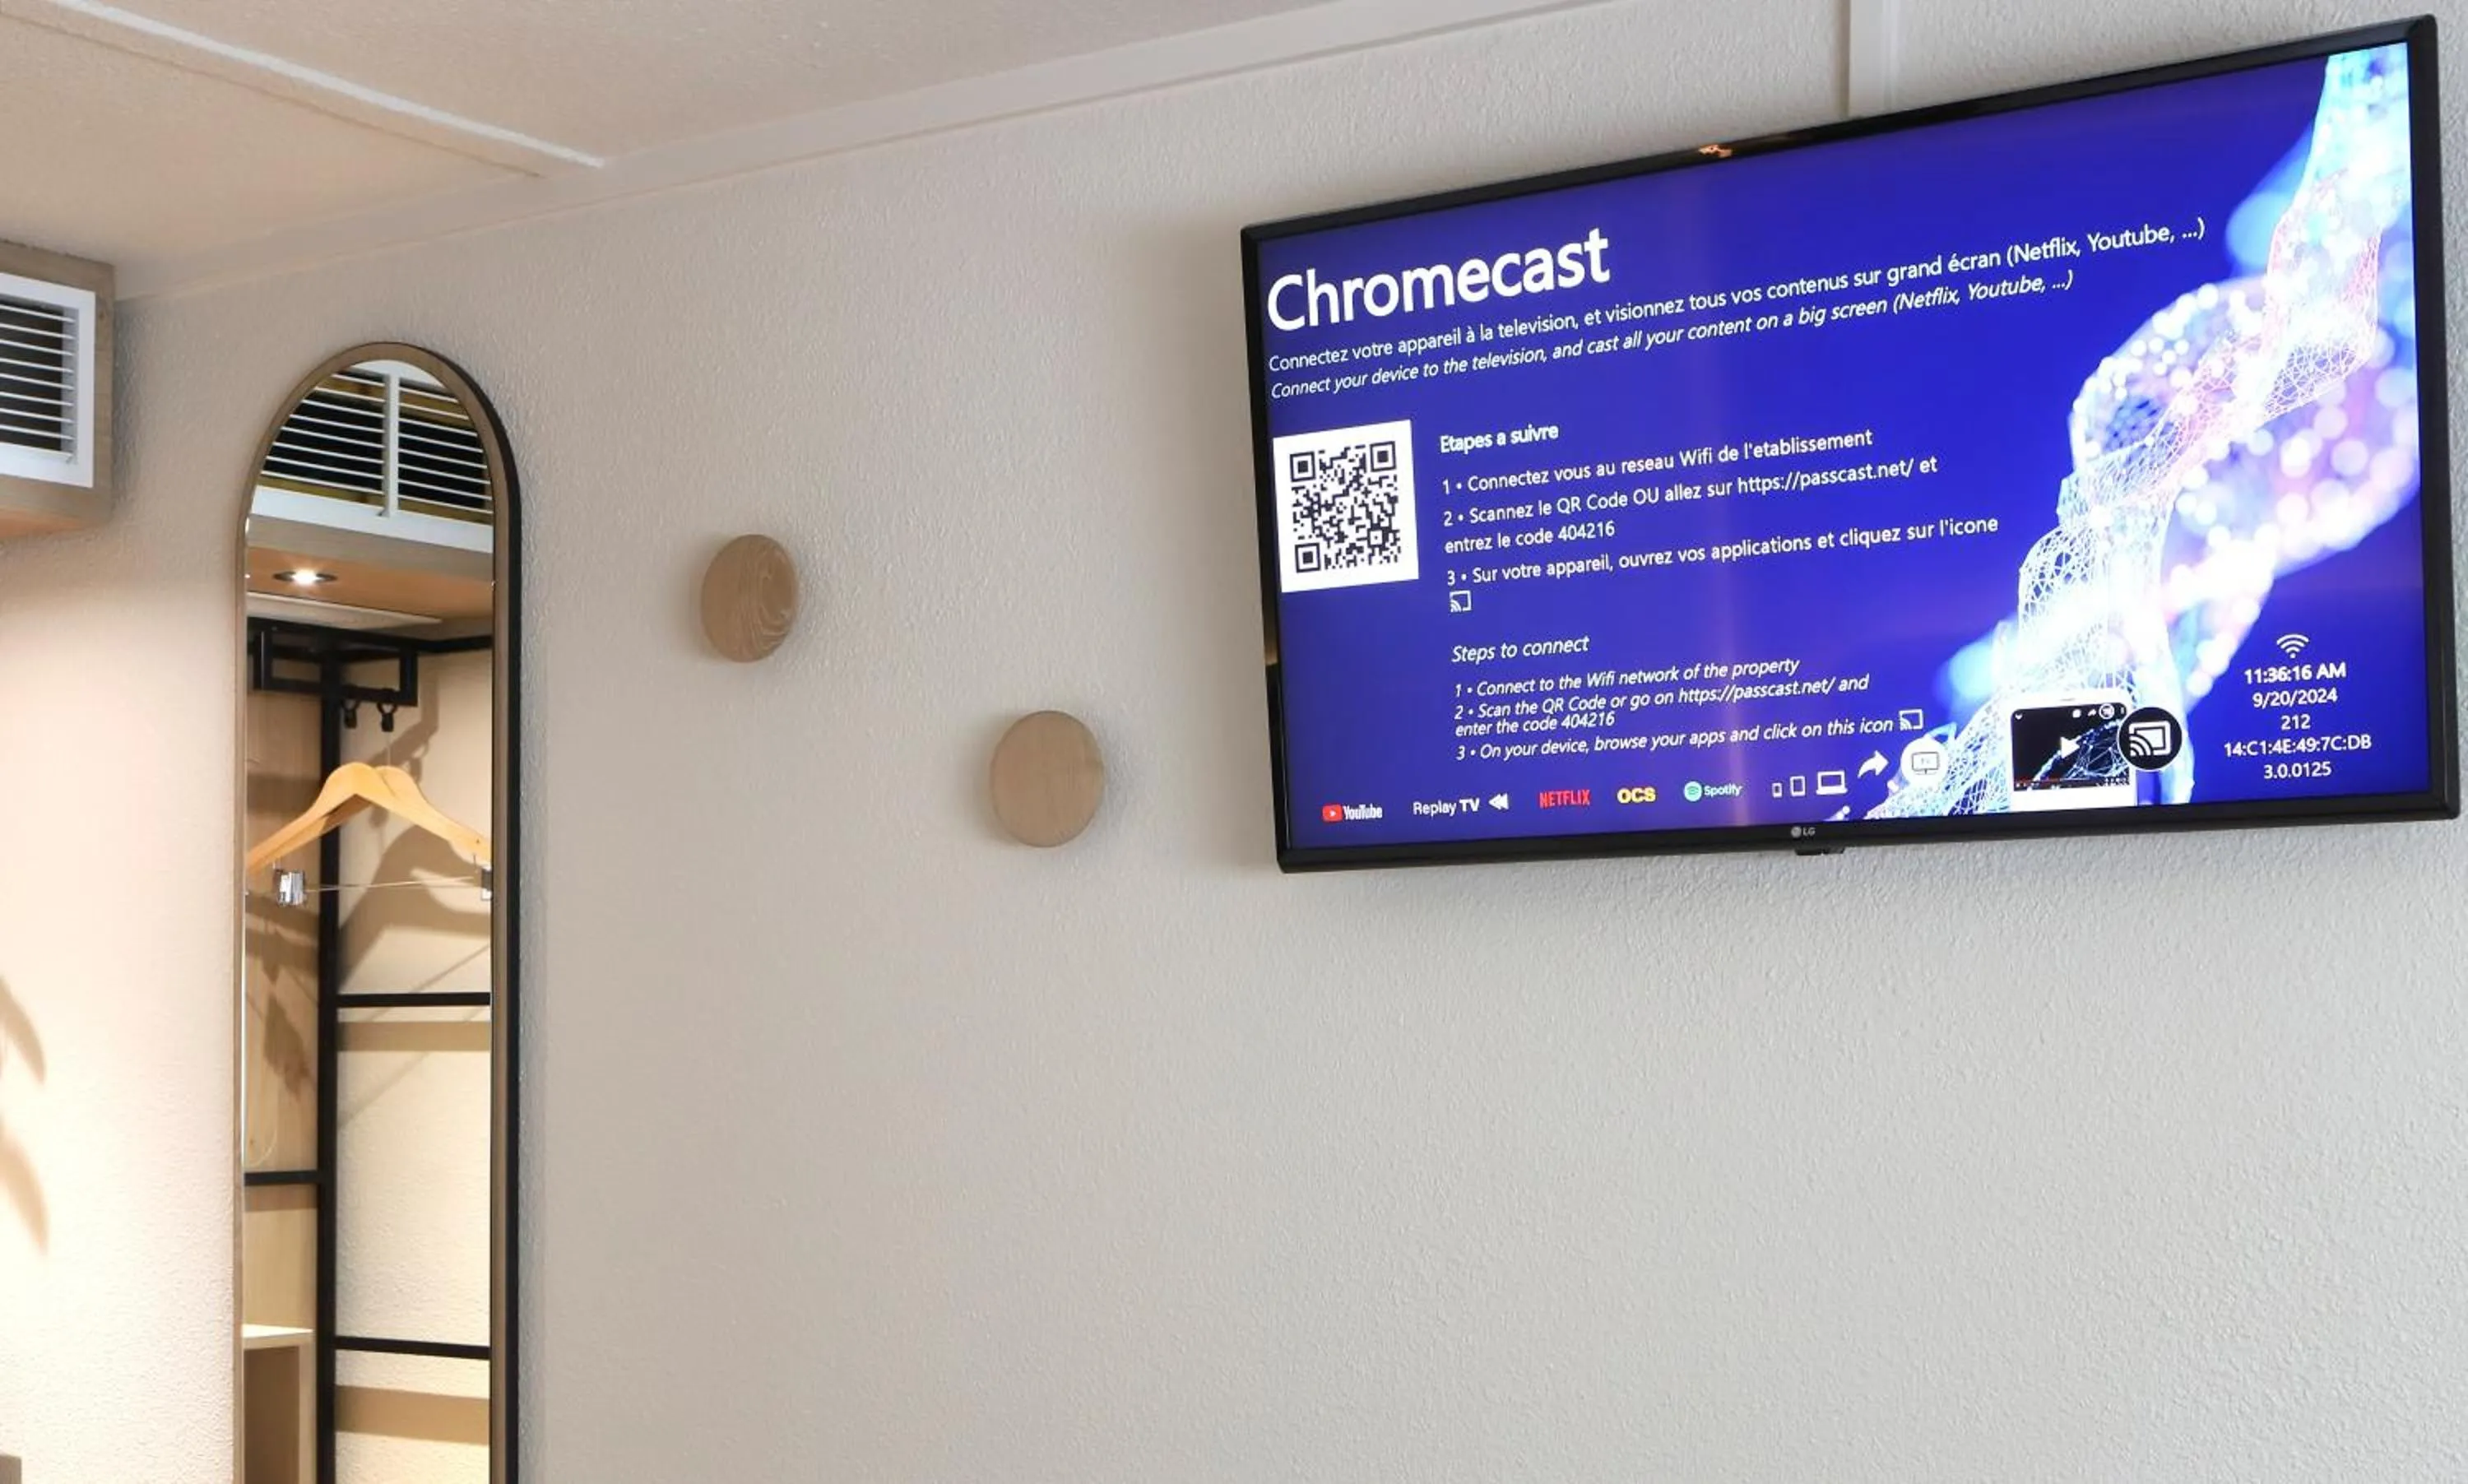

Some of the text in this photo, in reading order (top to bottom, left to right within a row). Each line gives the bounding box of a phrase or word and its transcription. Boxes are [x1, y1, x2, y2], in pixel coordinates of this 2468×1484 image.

[1268, 228, 1610, 331] Chromecast
[1269, 217, 2206, 372] Connectez votre appareil à la television, et visionnez tous vos contenus sur grand écran (Netflix, Youtube, ...)
[1272, 270, 2074, 400] Connect your device to the television, and cast all your content on a big screen (Netflix, Youtube, ...)
[1440, 424, 1559, 453] Etapes a suivre
[1442, 429, 1873, 494] 1 Connectez vous au reseau Wifi de l'etablissement
[1443, 456, 1938, 526] 2 Scannez le QR Code OU allez sur https://passcast.net/ et
[1445, 520, 1615, 554] entrez le code 404216
[1446, 517, 1999, 586] 3 Sur votre appareil, ouvrez vos applications et cliquez sur l'icone
[1451, 635, 1590, 665] Steps to connect
[1455, 658, 1800, 698] 1 Connect to the Wifi network of the property
[2244, 662, 2346, 684] 11:36:16 AM
[1454, 673, 1870, 721] 2 Scan the QR Code or go on https://passcast.net/ and
[2253, 688, 2337, 708] 9/20/2024
[1455, 710, 1616, 737] enter the code 404216
[2280, 715, 2311, 730] 212
[1455, 717, 1893, 761] 3 On your device, browse your apps and click on this icon
[2224, 734, 2372, 758] 14:C1:4E:49:7C:DB
[2264, 761, 2331, 779] 3.0.0125
[1539, 789, 1590, 809] NETFLIX
[1617, 786, 1656, 804] OCS
[1704, 782, 1742, 797] Spotify
[1343, 805, 1383, 820] YouTube
[1413, 798, 1479, 818] Replay TV
[1802, 827, 1816, 837] LG
